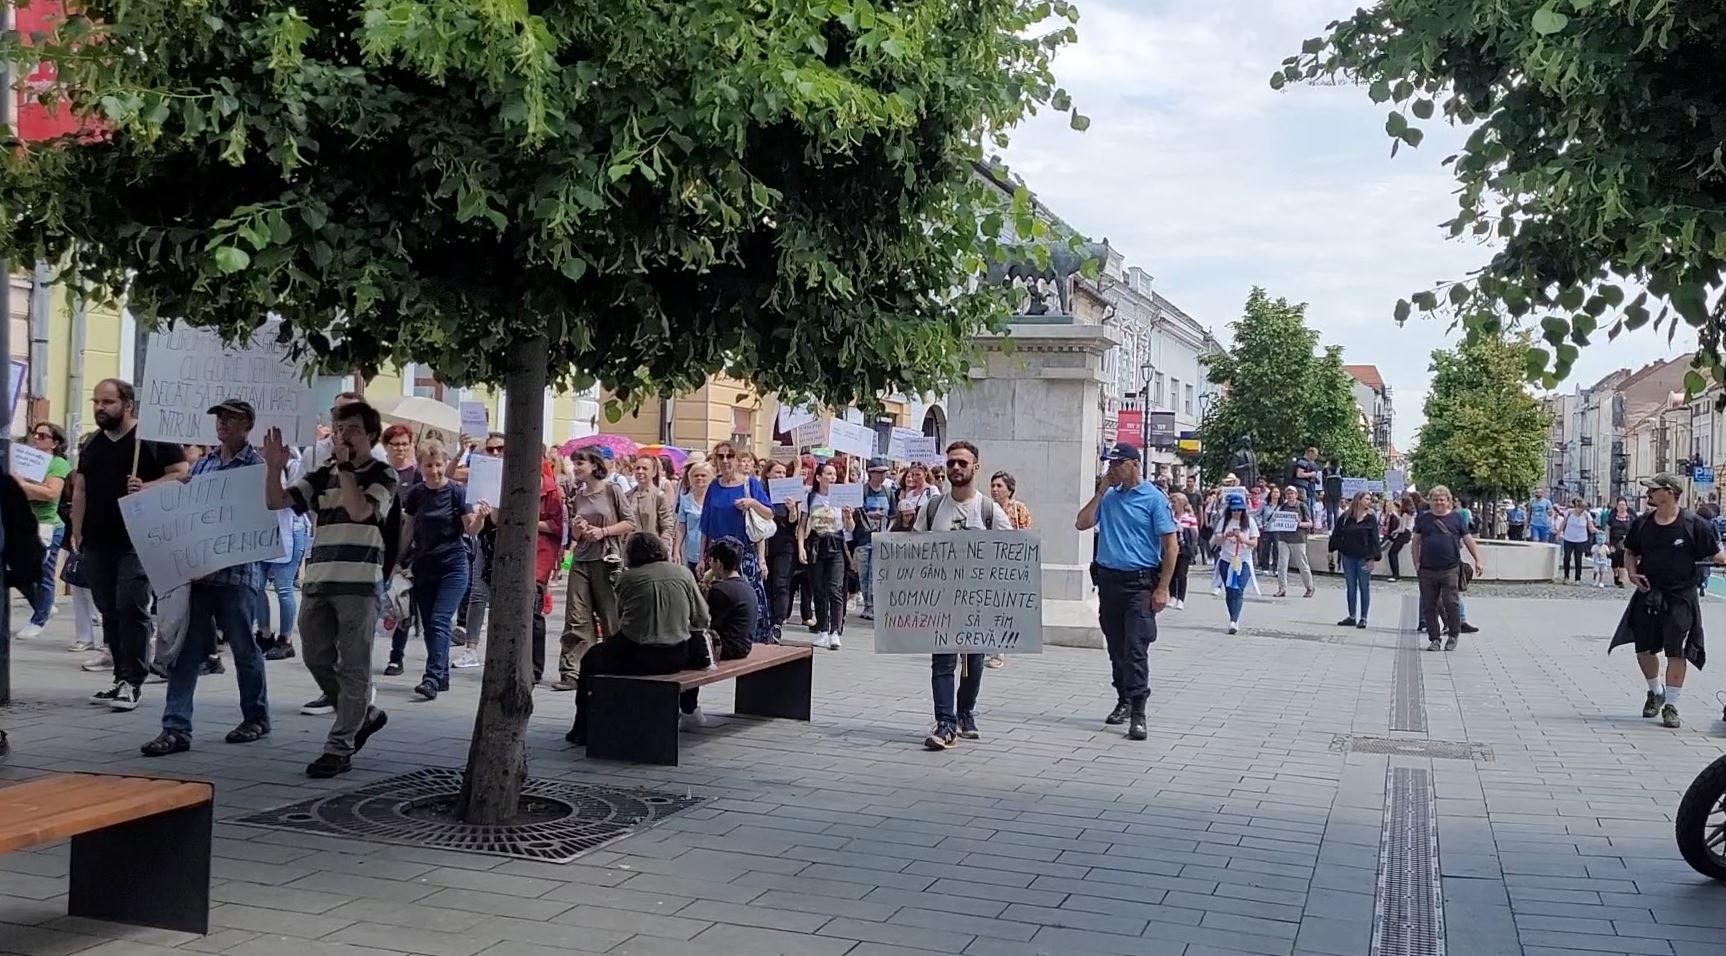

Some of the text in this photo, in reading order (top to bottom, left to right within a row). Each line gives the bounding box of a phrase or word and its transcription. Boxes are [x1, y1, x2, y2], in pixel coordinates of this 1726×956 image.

[966, 541, 986, 560] NE
[992, 539, 1039, 562] TREZIM
[877, 567, 889, 584] ȘI
[896, 567, 914, 581] UN
[920, 564, 947, 581] GÂND
[954, 566, 964, 581] NI
[971, 567, 984, 580] SE
[884, 610, 1013, 629] ÎNDRĂZNIM SĂ FIM
[934, 630, 948, 647] ÎN
